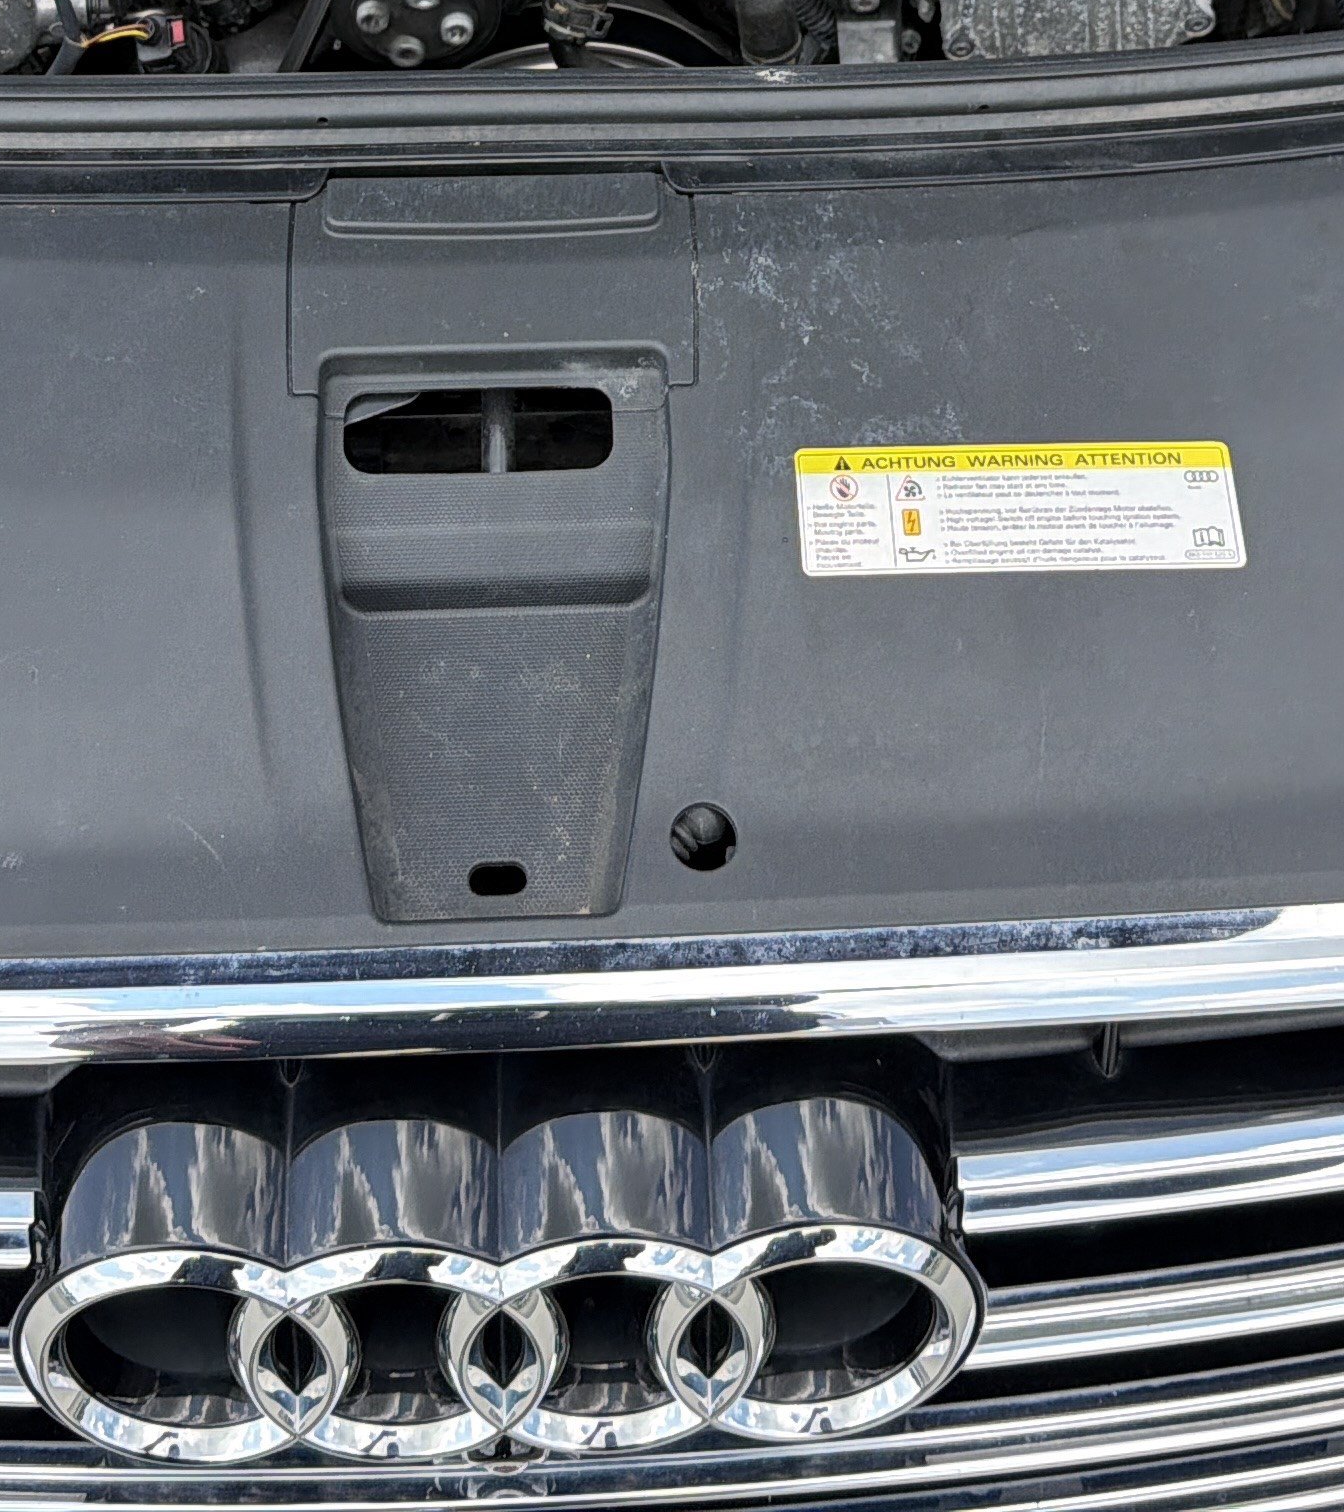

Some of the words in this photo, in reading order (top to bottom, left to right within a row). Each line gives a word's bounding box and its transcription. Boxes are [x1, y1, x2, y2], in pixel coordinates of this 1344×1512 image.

[861, 455, 956, 470] ACHTUNG
[966, 453, 1063, 468] WARNING
[1074, 451, 1182, 466] ATTENTION
